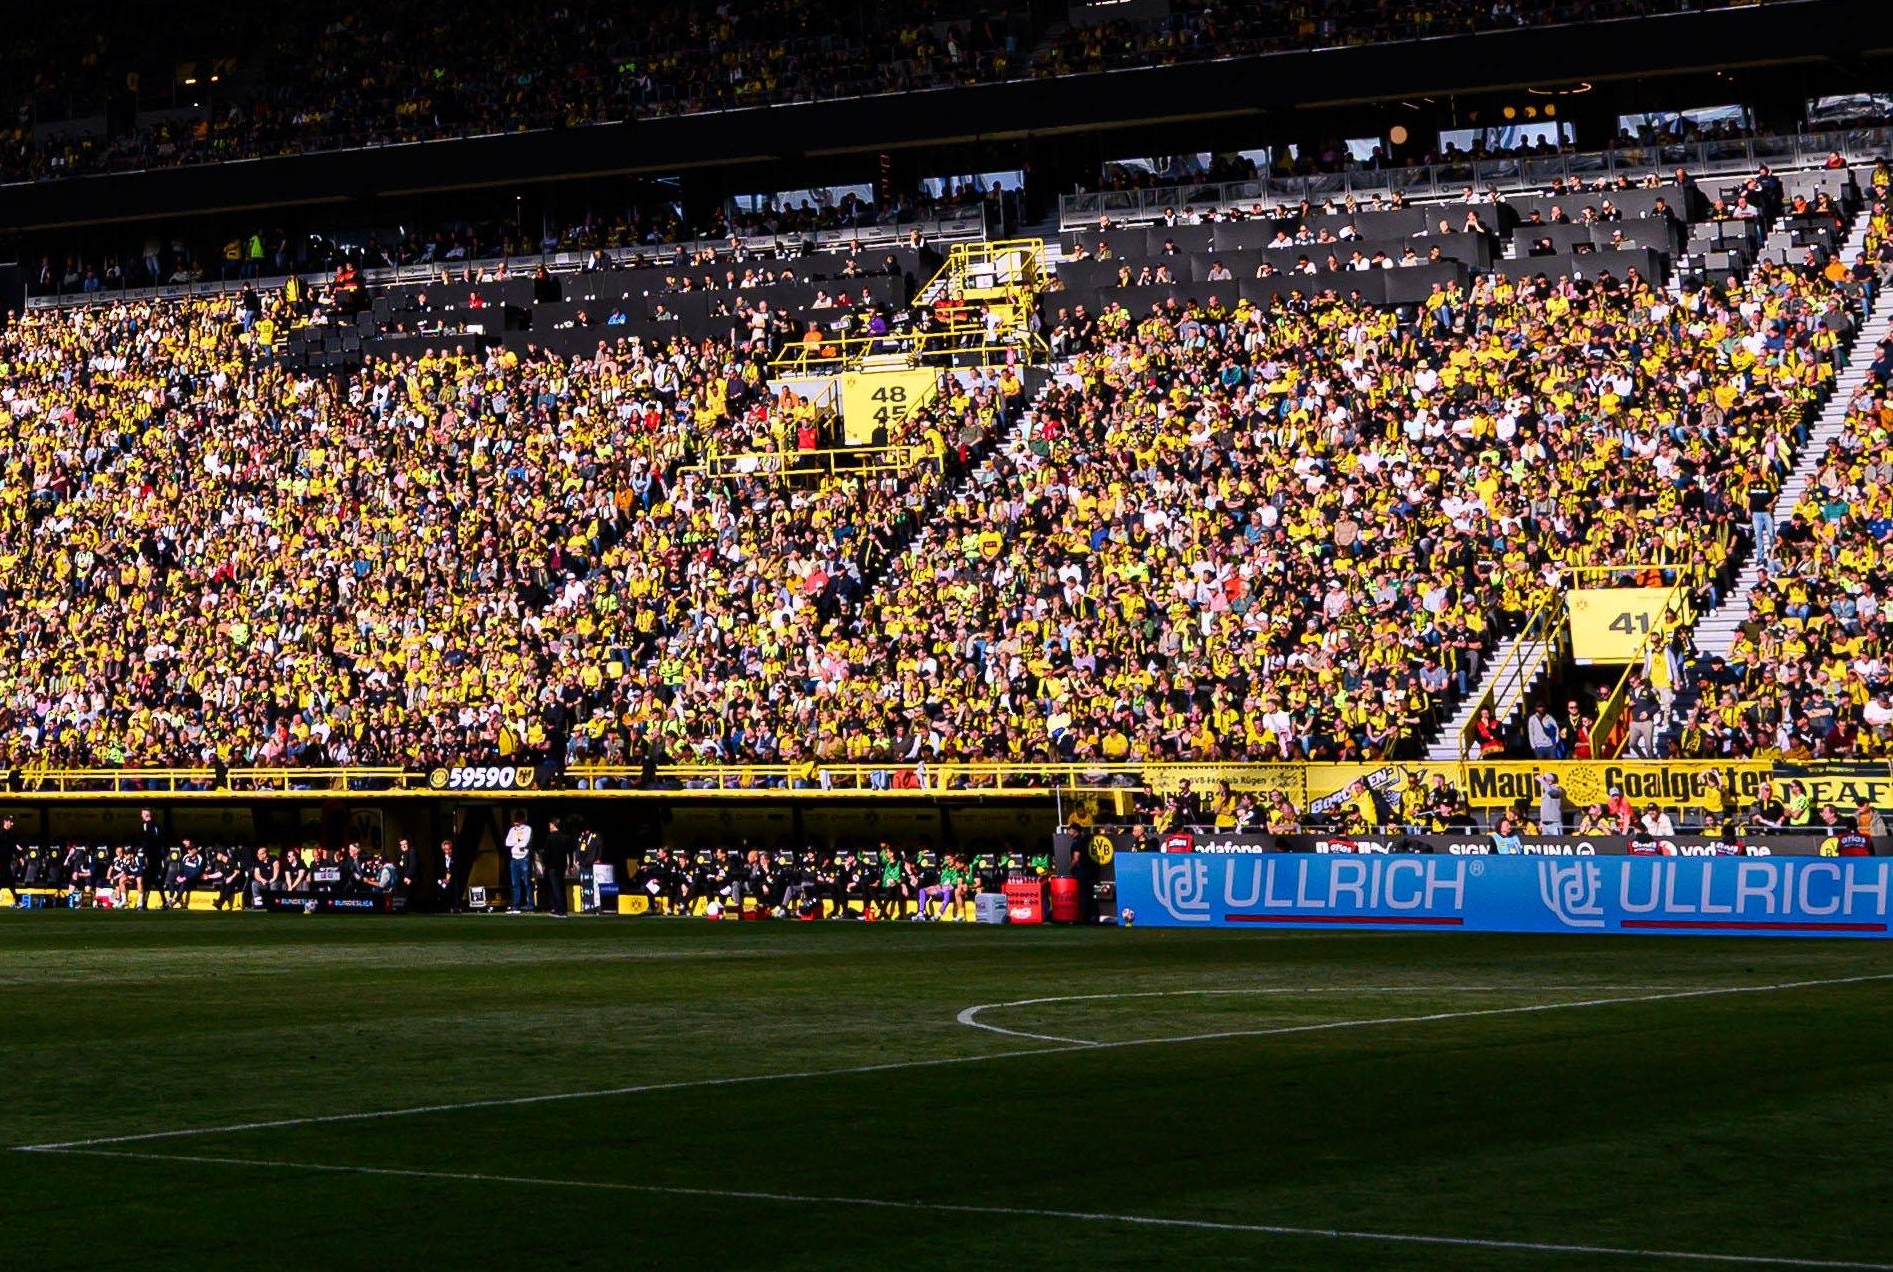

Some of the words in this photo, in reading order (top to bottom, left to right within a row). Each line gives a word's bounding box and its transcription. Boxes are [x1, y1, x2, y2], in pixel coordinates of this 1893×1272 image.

[871, 386, 907, 403] 48
[1608, 611, 1650, 635] 41
[449, 766, 516, 788] 59590
[1468, 766, 1558, 801] Magi
[1604, 766, 1774, 803] Goalgeter
[1618, 860, 1890, 916] ULLRICH
